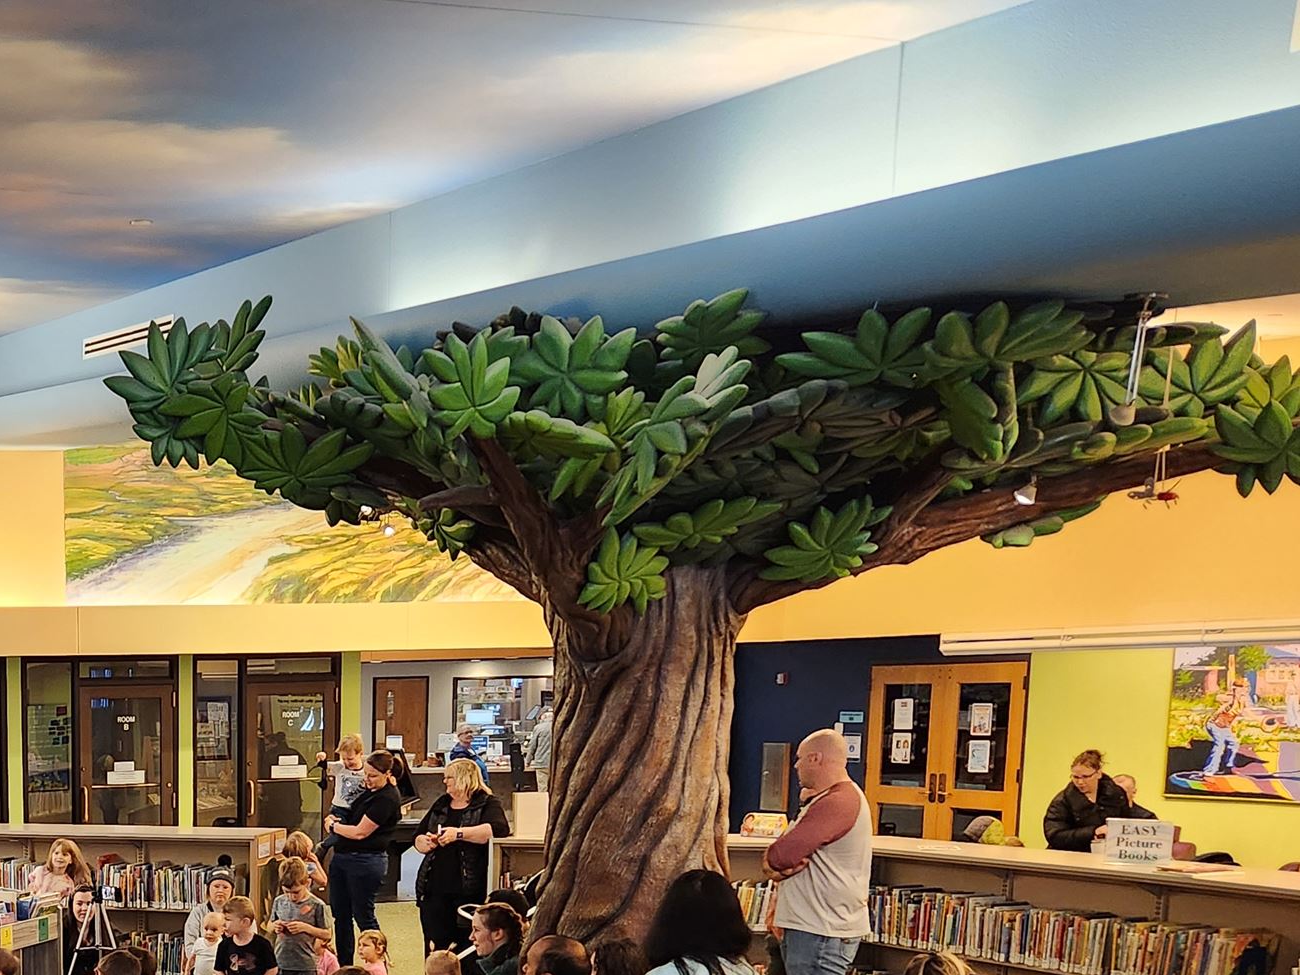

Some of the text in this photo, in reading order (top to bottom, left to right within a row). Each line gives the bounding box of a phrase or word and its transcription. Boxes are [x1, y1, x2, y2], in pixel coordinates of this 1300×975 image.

[282, 711, 300, 719] ROOM
[287, 719, 294, 727] C
[1122, 825, 1160, 836] EASY
[1116, 836, 1163, 849] Picture
[1118, 849, 1158, 861] Books
